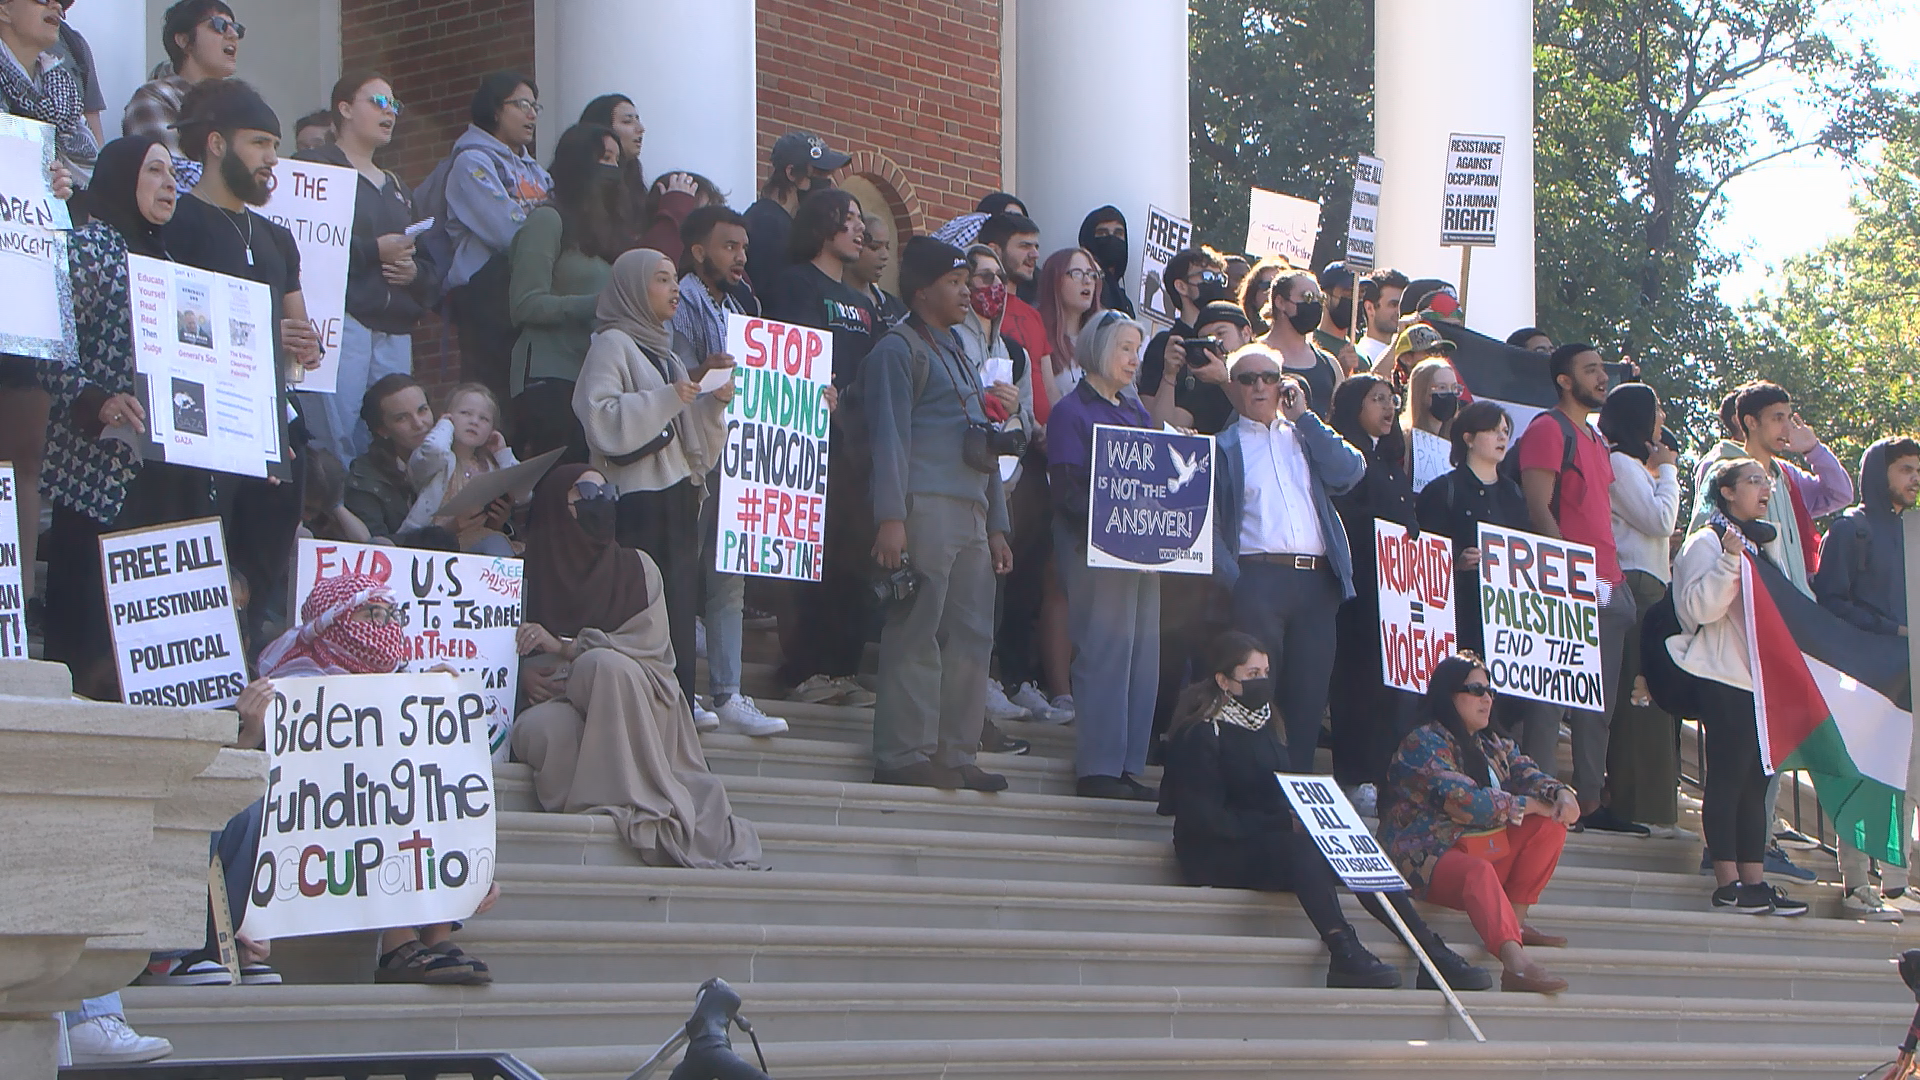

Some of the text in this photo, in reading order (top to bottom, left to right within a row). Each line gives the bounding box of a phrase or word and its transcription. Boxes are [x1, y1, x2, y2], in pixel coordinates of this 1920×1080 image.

[1451, 139, 1502, 154] RESISTANCE
[1456, 156, 1492, 170] AGAINST
[292, 171, 329, 201] THE
[1447, 172, 1499, 187] OCCUPATION
[1445, 193, 1497, 208] IS A HUMAN
[1148, 211, 1190, 253] FREE
[1444, 207, 1495, 231] RIGHT!
[140, 300, 157, 311] Read
[142, 328, 158, 339] Then
[744, 319, 823, 379] STOP
[727, 367, 828, 438] FUNDING
[723, 420, 828, 495] GENOCIDE
[1107, 440, 1155, 471] WAR
[1098, 476, 1166, 500] IS NOT THE
[737, 488, 822, 542] #FREE
[1105, 506, 1193, 538] ANSWER!
[107, 536, 222, 584] FREE ALL
[723, 530, 822, 580] PALESTINE
[1377, 530, 1453, 610] NEUTRALITY
[1481, 531, 1596, 602] FREE
[114, 586, 228, 625] PALESTINIAN
[1482, 585, 1598, 646] PALESTINE
[130, 634, 230, 673] POLITICAL
[1494, 630, 1584, 665] END THE
[129, 672, 245, 708] PRISONERS
[1490, 659, 1602, 706] OCCUPATION
[275, 686, 384, 756] Biden
[262, 758, 416, 837] Funding
[1290, 781, 1335, 805] END
[1310, 807, 1351, 830] ALL
[1314, 835, 1380, 856] U.S. AID
[1330, 857, 1393, 873] TO ISRAEL!
